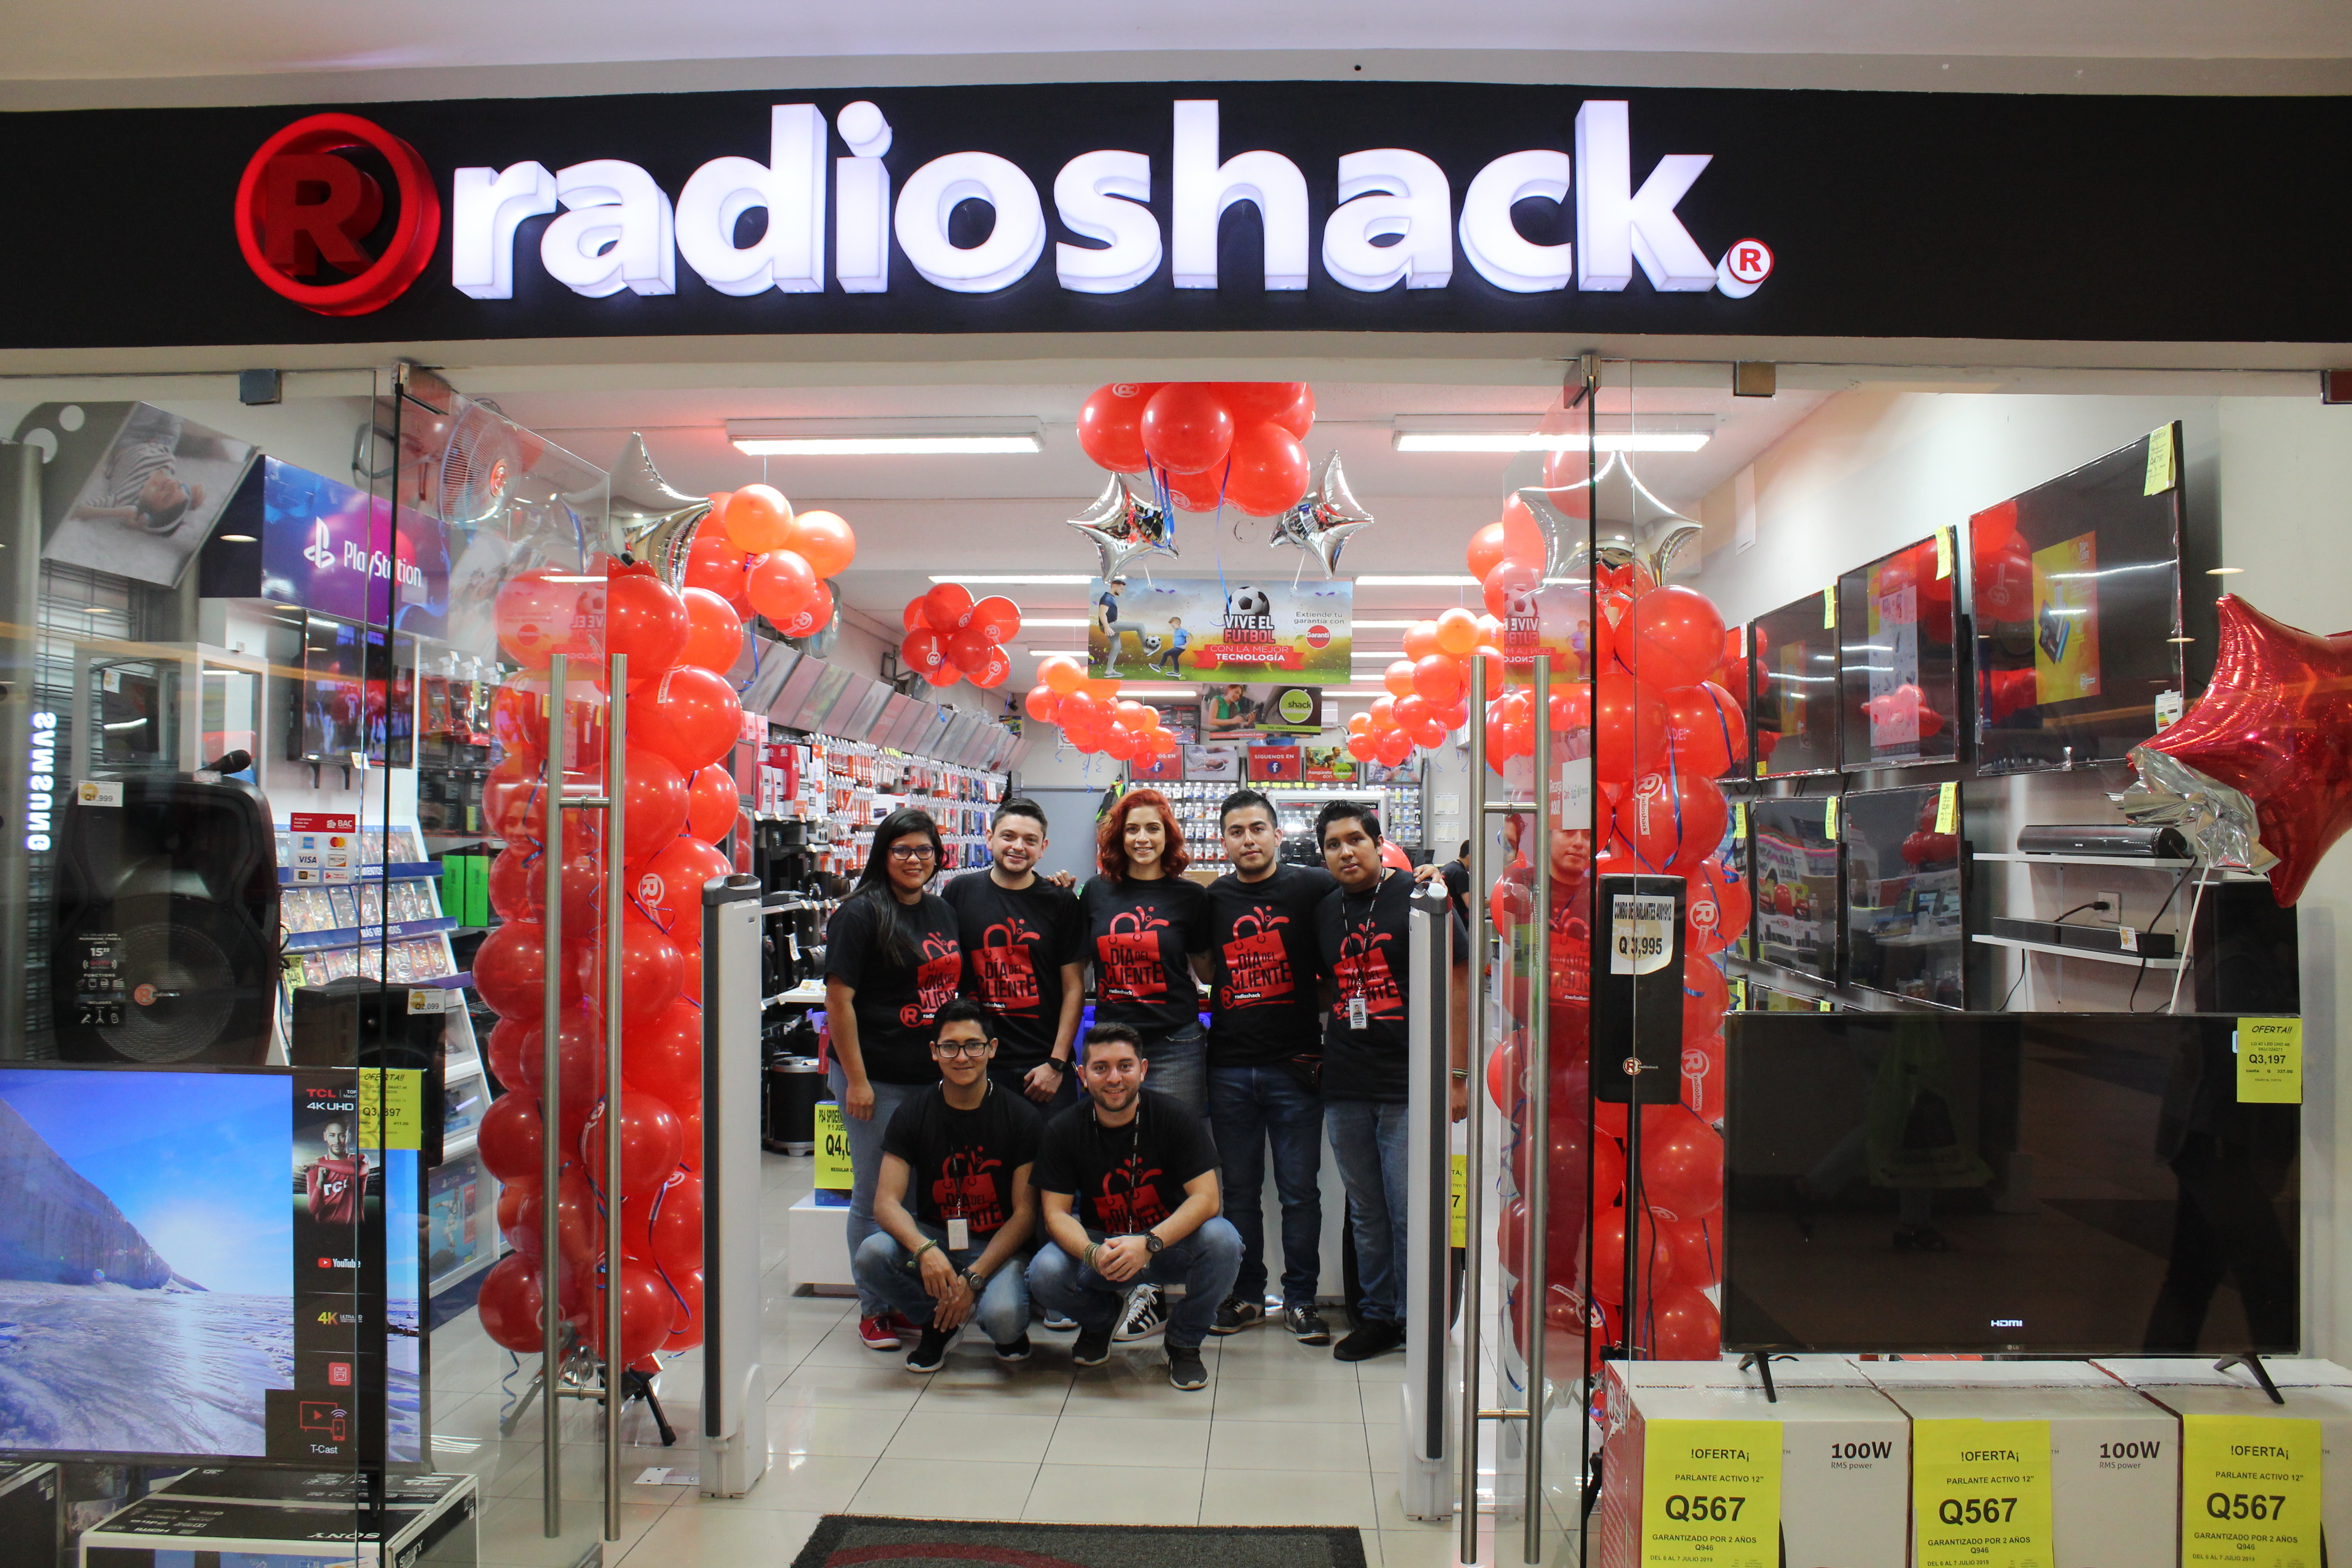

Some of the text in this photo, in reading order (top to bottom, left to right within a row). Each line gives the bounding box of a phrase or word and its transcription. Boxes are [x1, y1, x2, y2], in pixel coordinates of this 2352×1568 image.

[453, 99, 1720, 299] radioshack
[1224, 615, 1274, 630] VIVE EL
[1224, 625, 1276, 644] FÚTBOL
[1215, 653, 1285, 662] TECNOLOGÍA
[360, 926, 373, 938] MÁS
[1110, 945, 1151, 966] DÍA DEL
[1237, 949, 1278, 970] DÍA DEL
[985, 958, 1024, 980] DÍA DEL
[1102, 961, 1164, 985] CLIENTE
[1229, 960, 1292, 990] CLIENTE
[975, 974, 1038, 998] CLIENTE
[2251, 1025, 2293, 1034] OFERTA!!
[2249, 1054, 2286, 1065] Q3,197
[306, 1088, 336, 1098] TCL
[307, 1102, 354, 1111] 4K UHD
[318, 1311, 338, 1325] 4K
[310, 1445, 338, 1454] T-Cast
[1831, 1441, 1892, 1460] 100W
[2099, 1441, 2161, 1459] 100W
[1849, 1462, 1872, 1471] power
[2117, 1461, 2141, 1470] power
[1666, 1494, 1745, 1522] Q567
[1939, 1498, 2017, 1526] Q567
[2206, 1492, 2285, 1520] Q567
